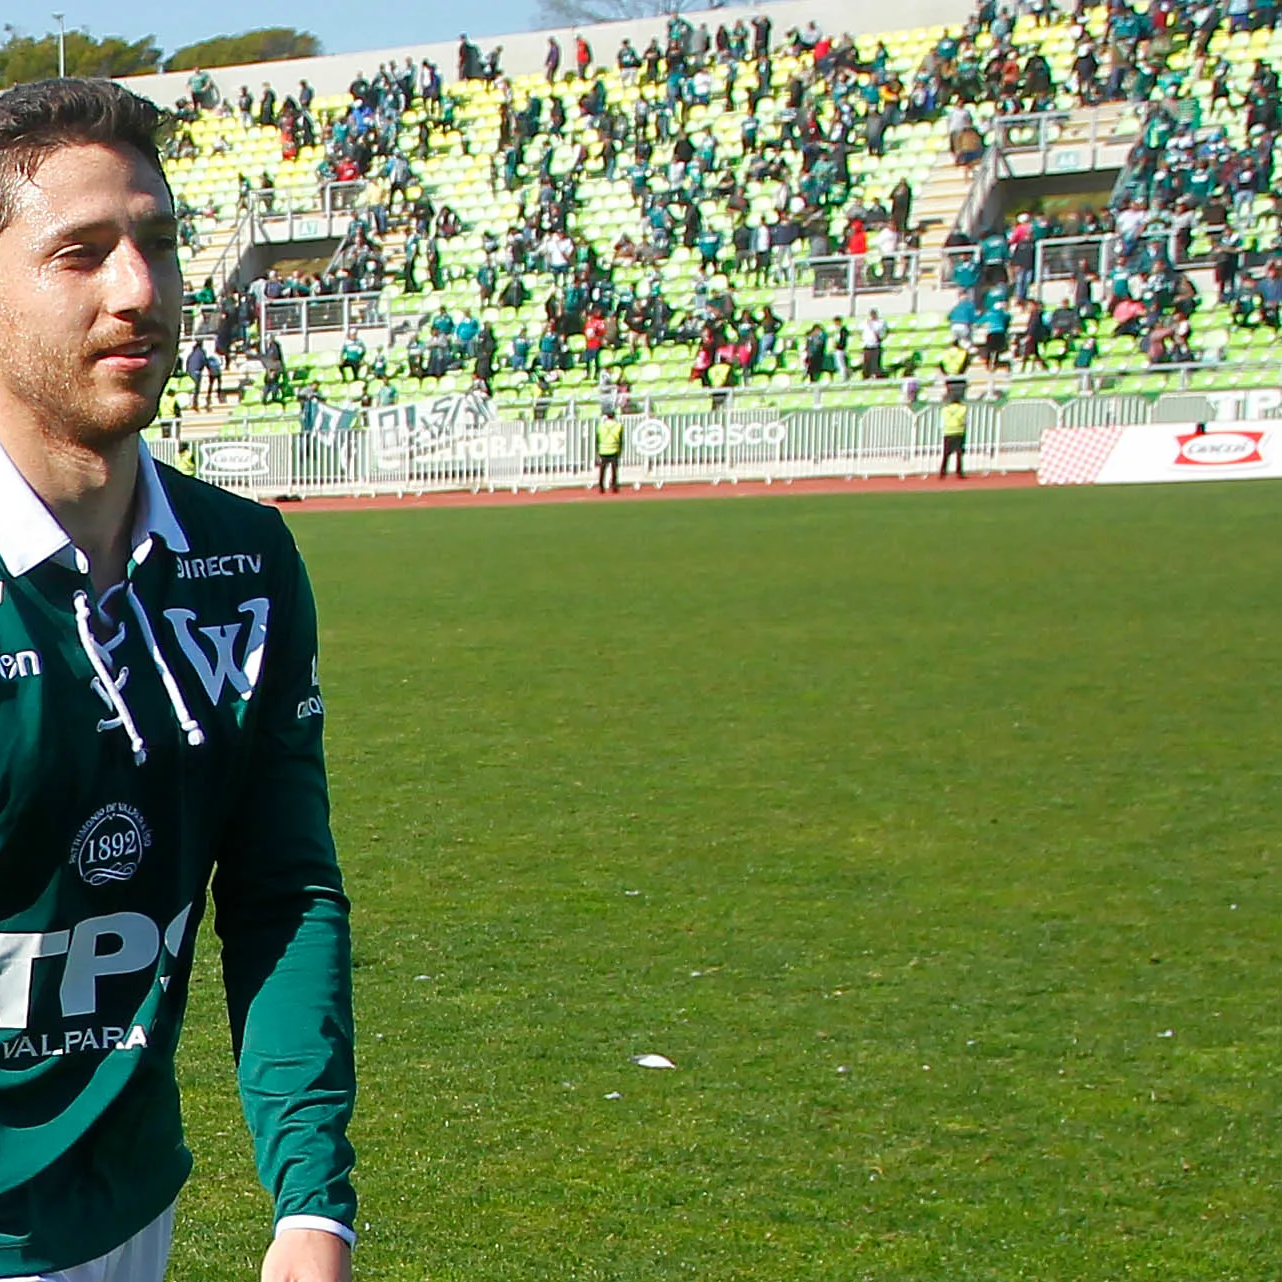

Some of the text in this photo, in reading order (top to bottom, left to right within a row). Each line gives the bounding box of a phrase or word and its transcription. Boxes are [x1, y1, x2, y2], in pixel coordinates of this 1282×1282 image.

[177, 554, 263, 579] DIRECTV
[85, 829, 138, 864] 1892
[2, 1024, 149, 1060] VALPARA
